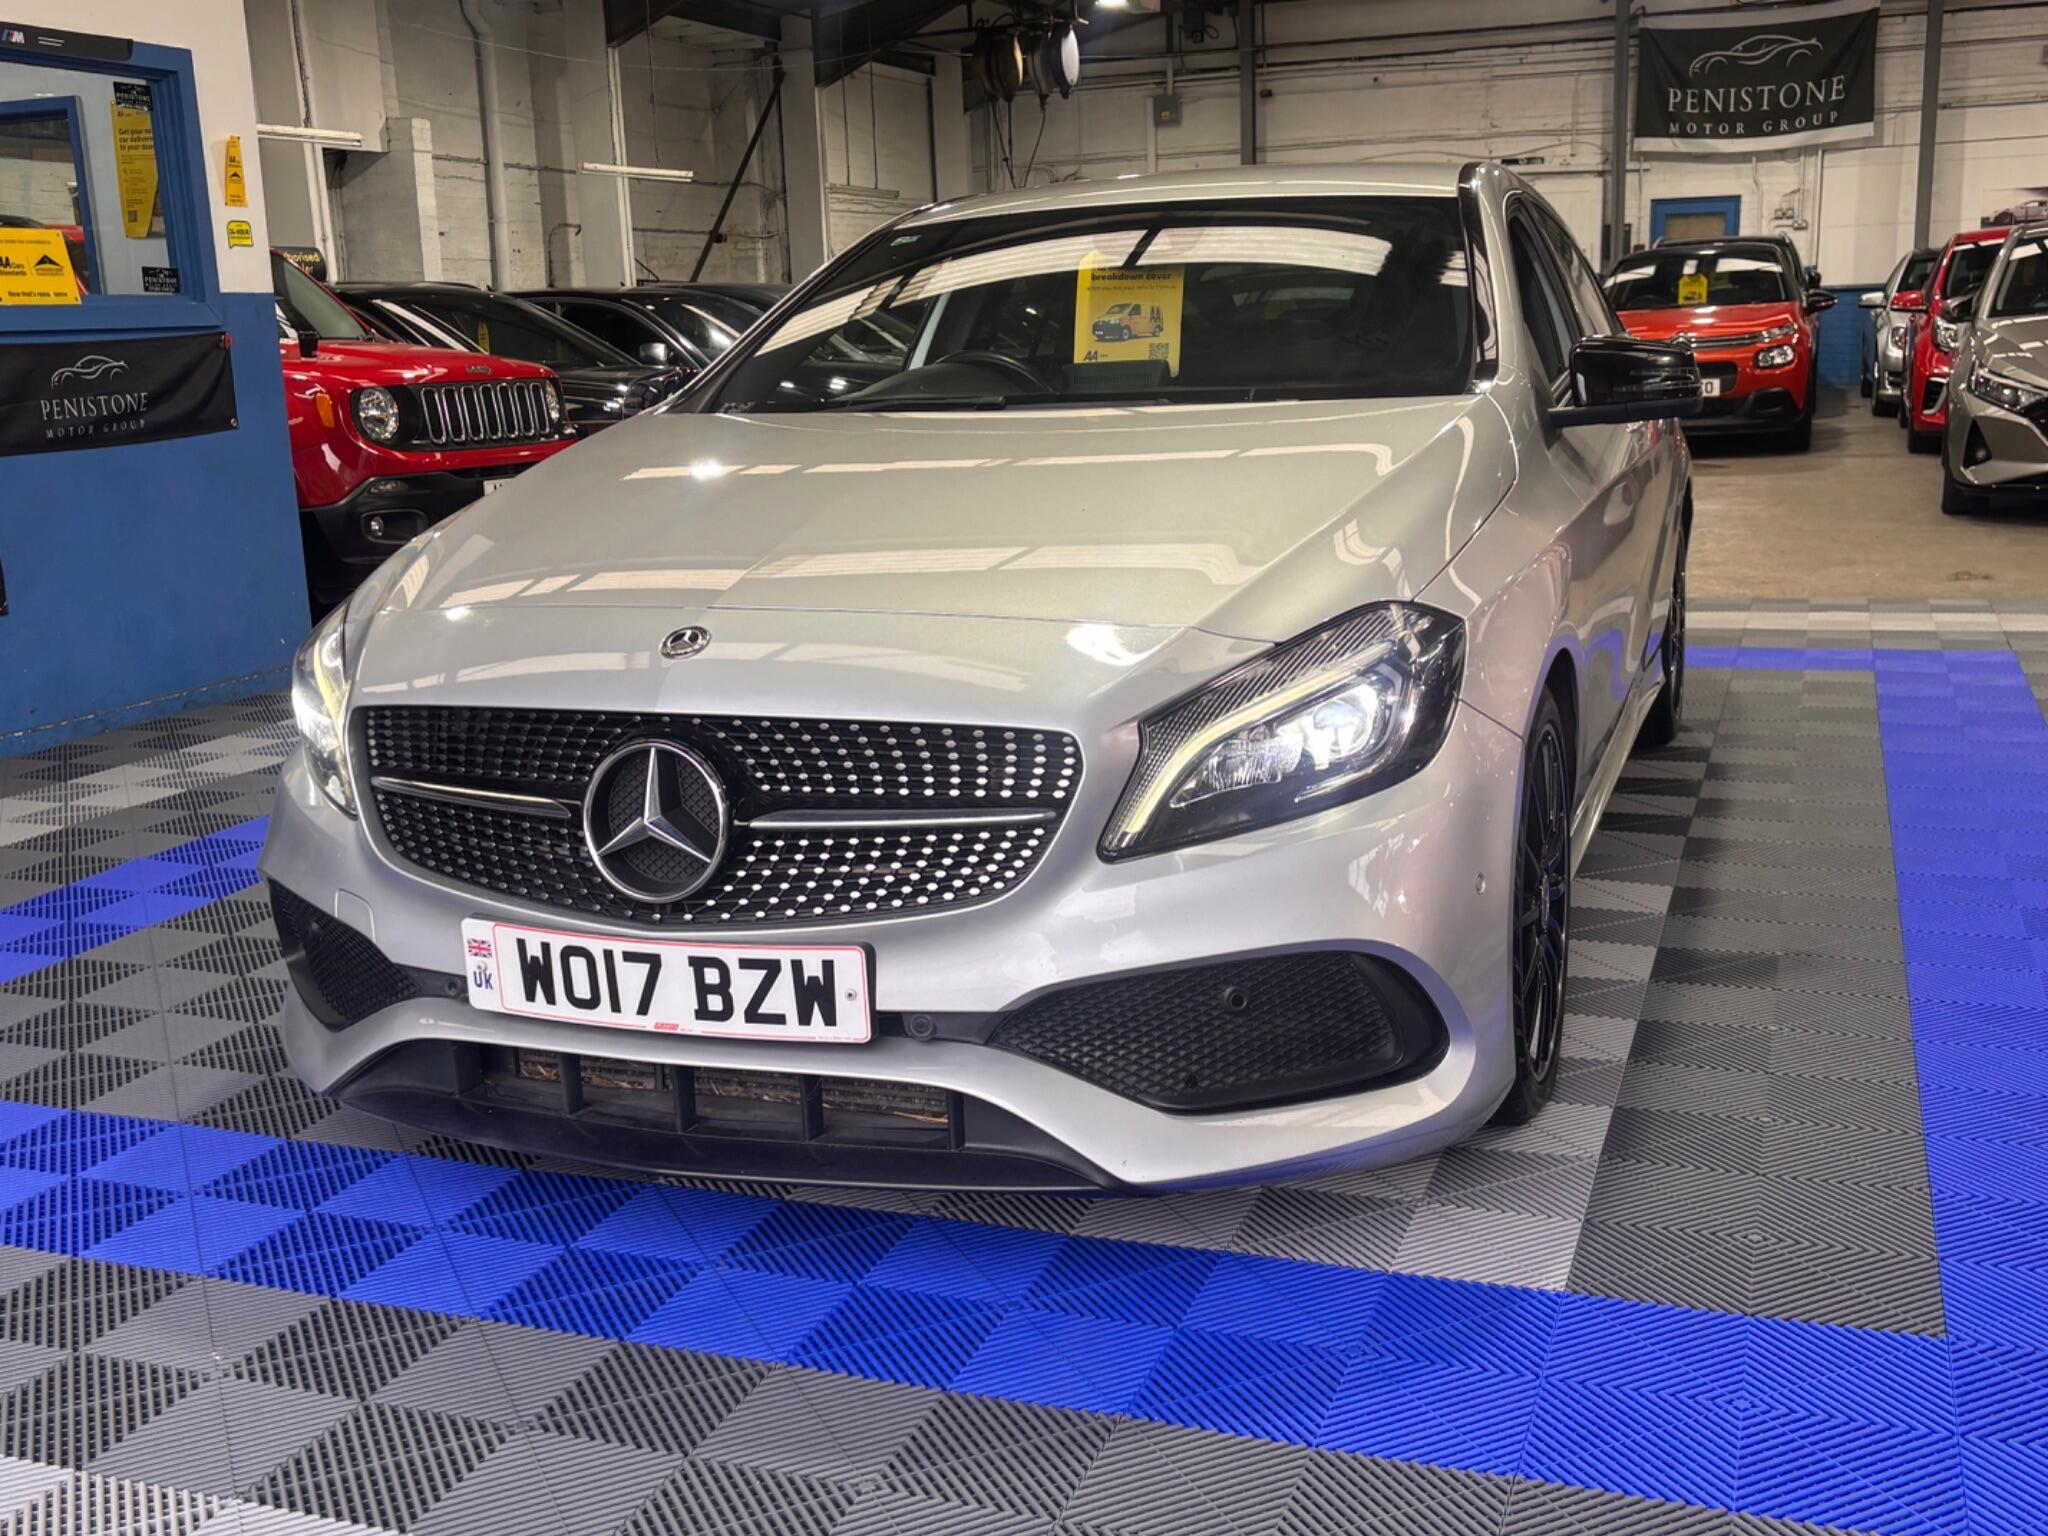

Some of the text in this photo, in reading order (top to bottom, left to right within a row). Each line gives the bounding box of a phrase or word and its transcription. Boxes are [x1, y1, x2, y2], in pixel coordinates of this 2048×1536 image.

[1668, 75, 1846, 113] PENISTONE
[1669, 111, 1839, 134] MOTOR GROUP
[1091, 272, 1172, 281] breakdown cover
[1083, 350, 1098, 361] AA
[40, 392, 149, 421] PENISTONE
[46, 419, 147, 439] MOTOR GROUP
[473, 970, 493, 990] UK
[516, 937, 837, 1027] WO17 BZW
